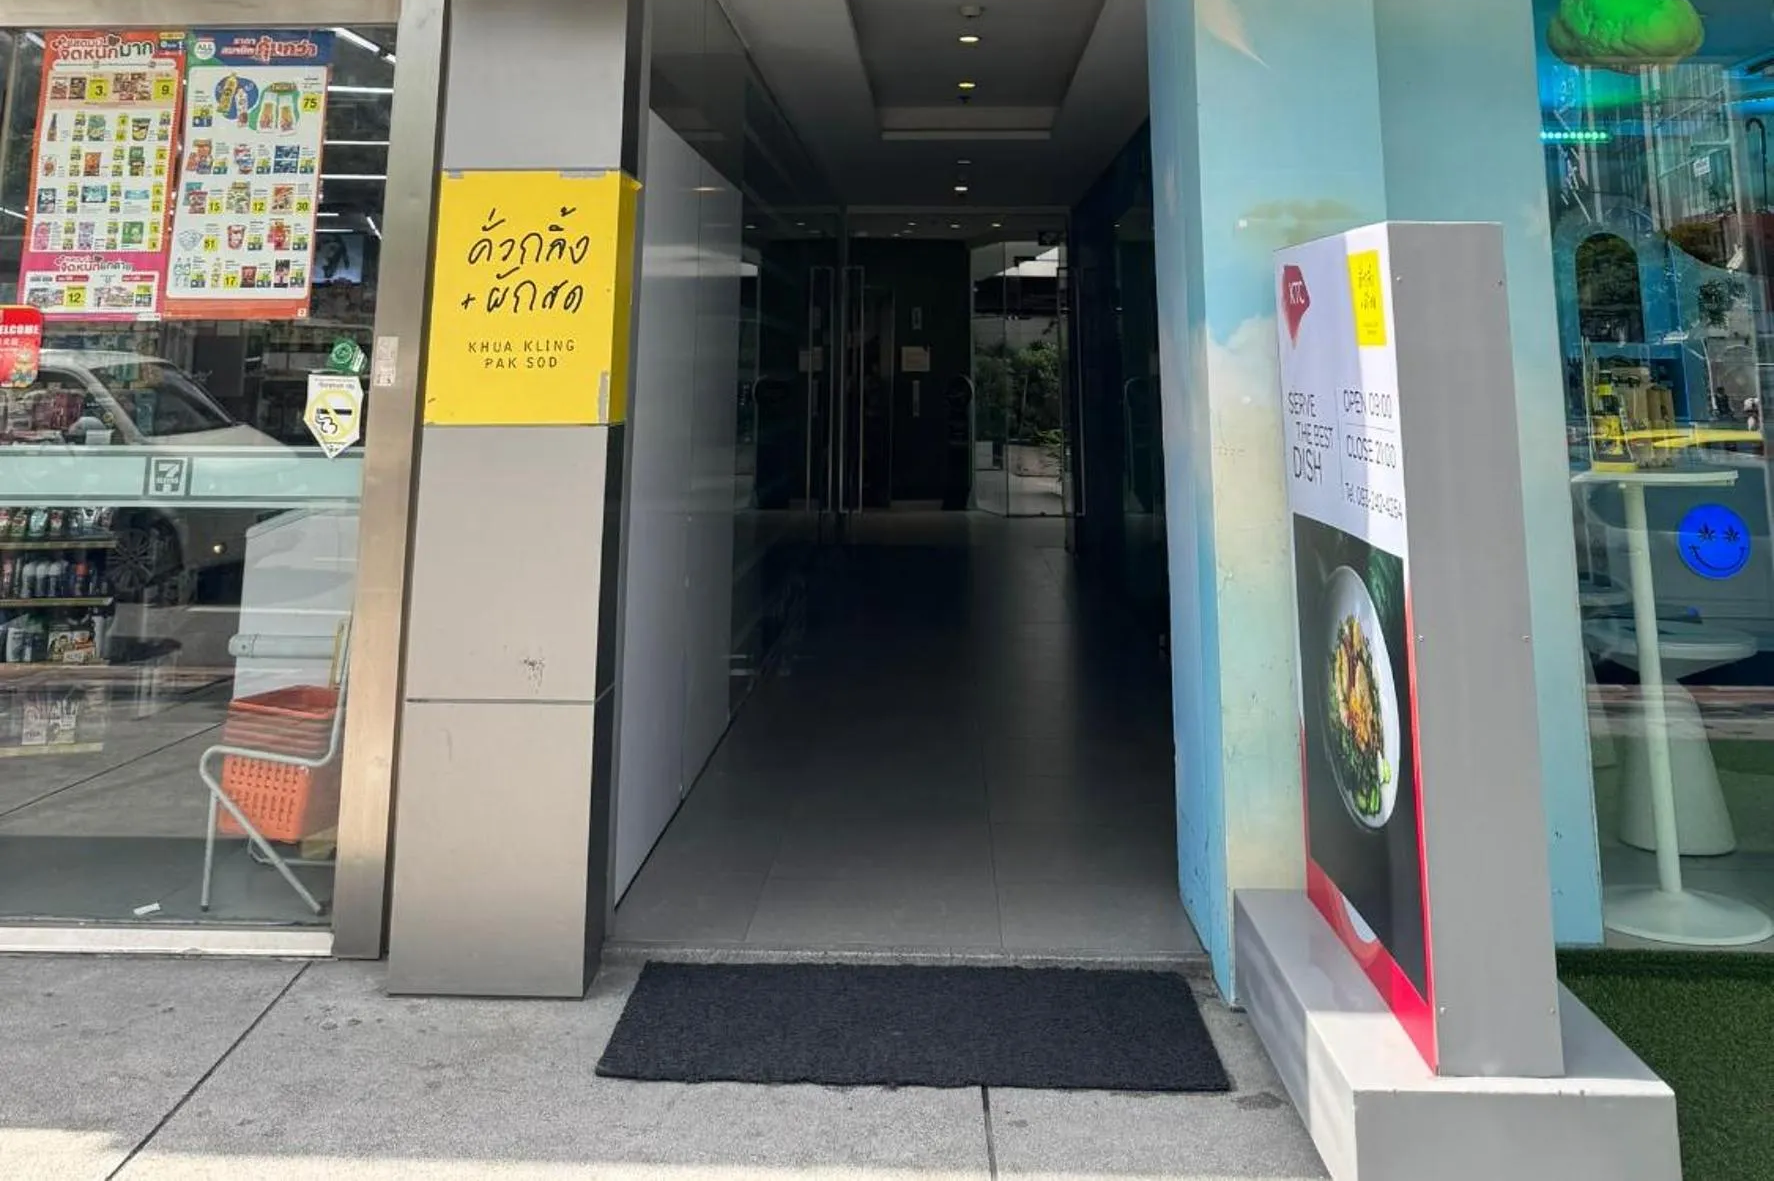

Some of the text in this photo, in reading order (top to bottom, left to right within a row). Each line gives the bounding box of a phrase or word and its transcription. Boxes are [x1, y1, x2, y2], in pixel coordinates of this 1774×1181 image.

[303, 97, 318, 109] 75
[467, 206, 590, 265] คั่วกลิ้ง
[68, 292, 81, 304] 12
[486, 266, 584, 315] ผักสด
[468, 339, 576, 354] KHUA KLING
[484, 356, 558, 369] PAK SOD
[1293, 446, 1323, 485] DISH
